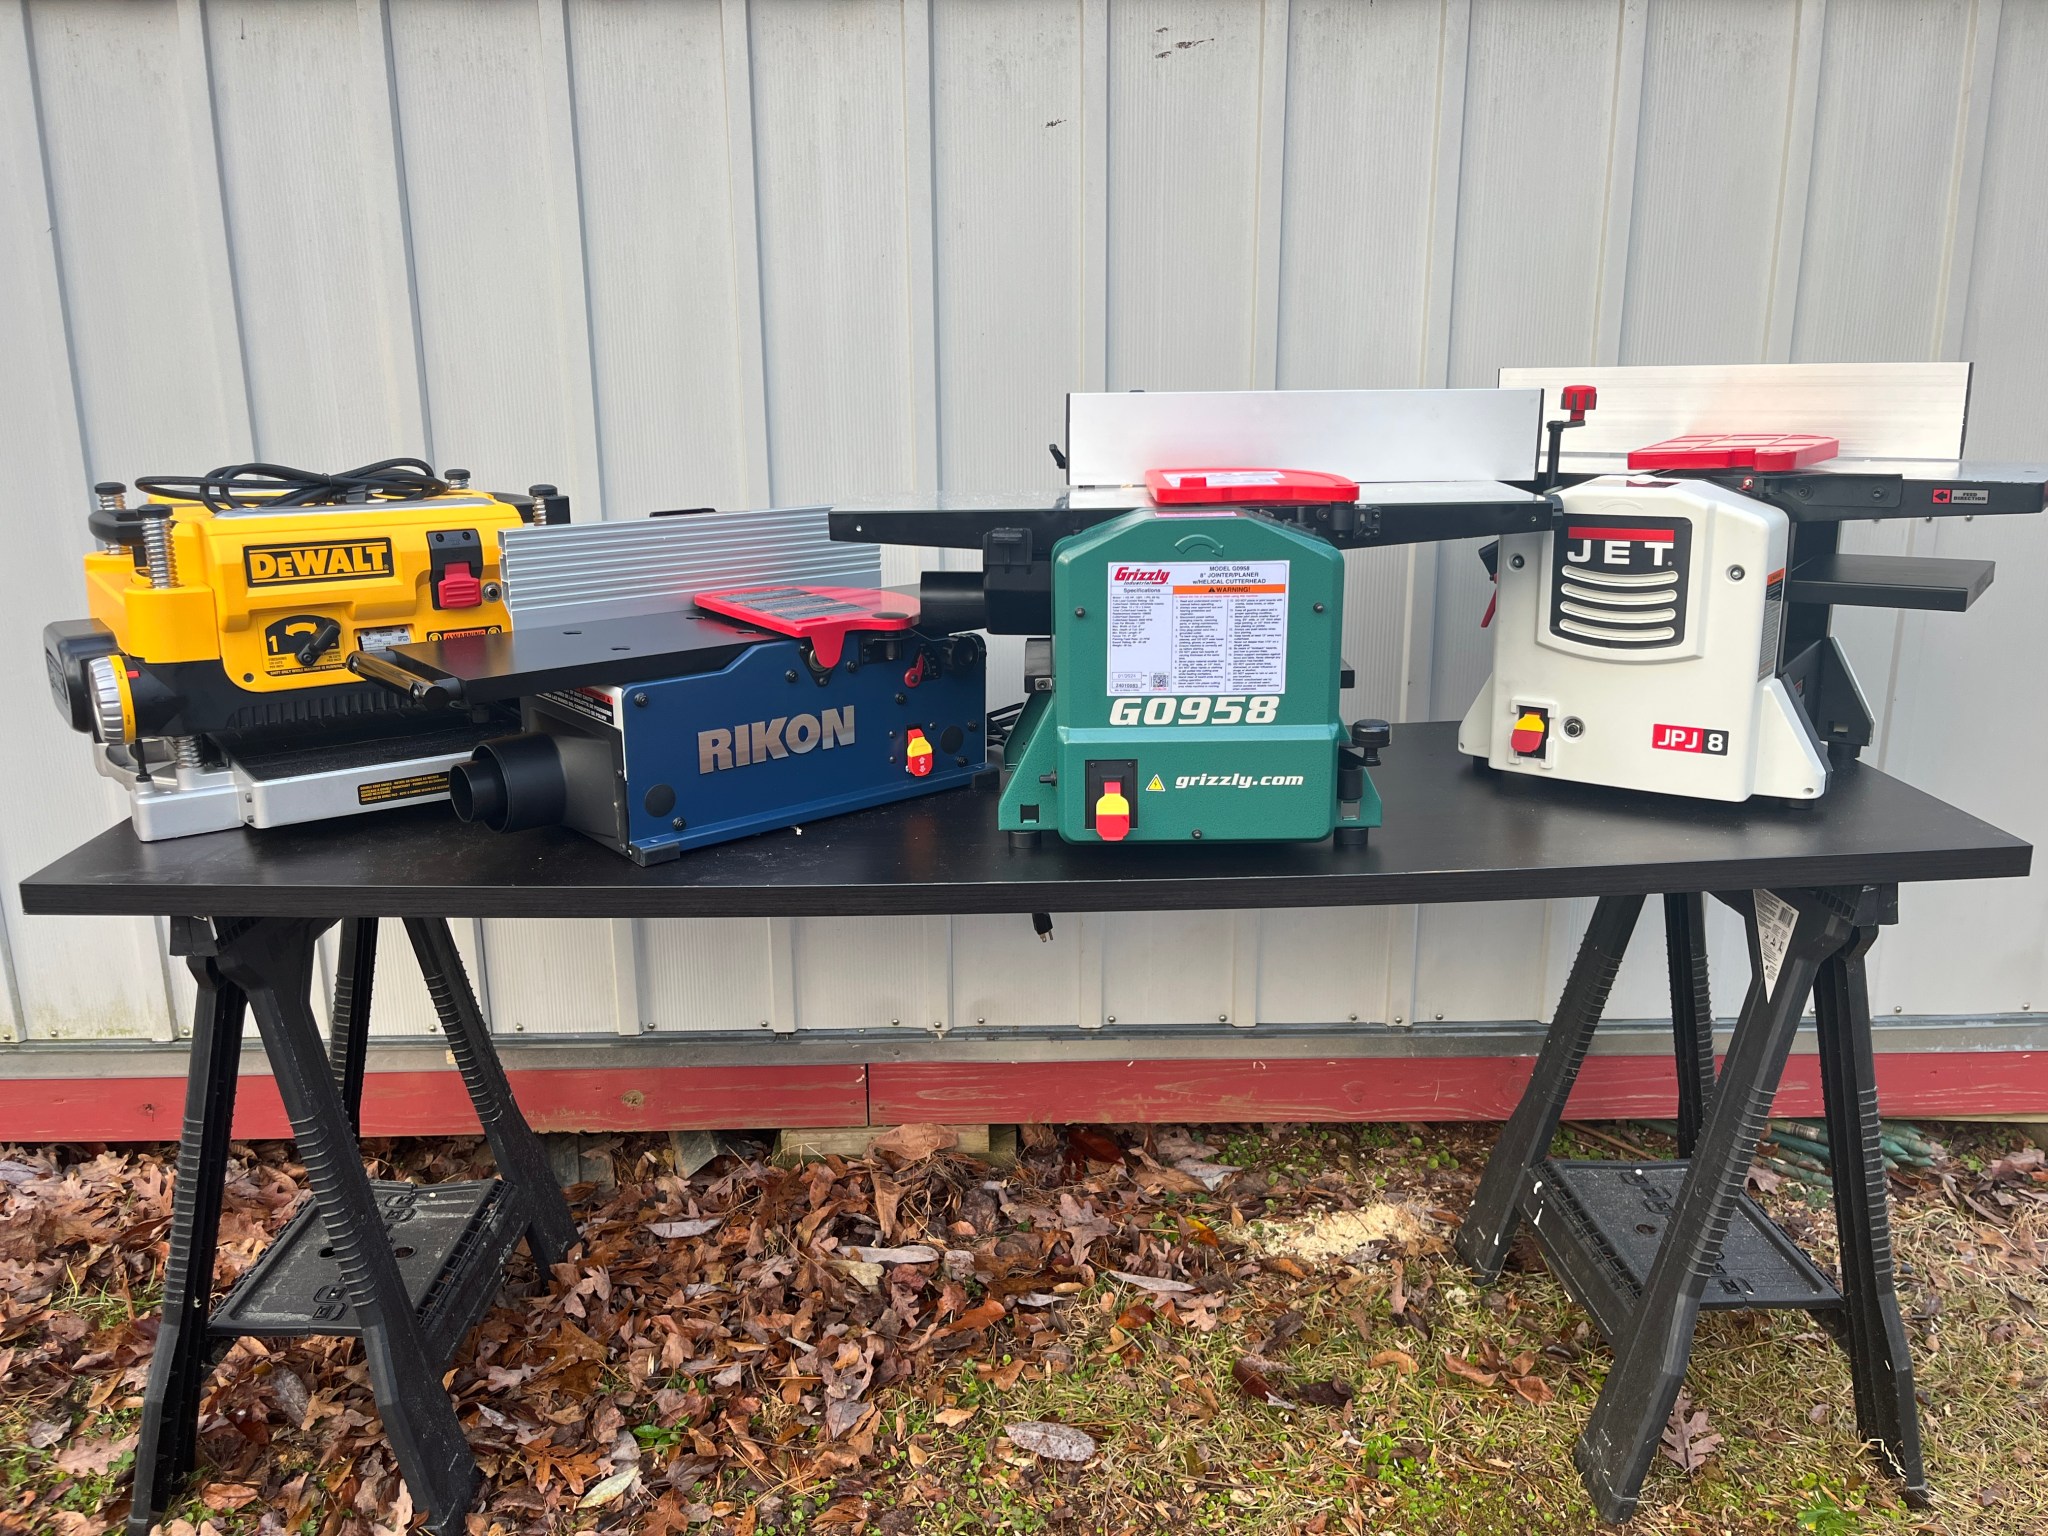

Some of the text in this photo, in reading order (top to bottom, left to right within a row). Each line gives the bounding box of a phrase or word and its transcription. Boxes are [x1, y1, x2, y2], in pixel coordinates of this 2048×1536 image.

[249, 545, 388, 580] DEWALT
[1566, 539, 1674, 567] JET
[1114, 566, 1170, 584] Grizzly
[268, 636, 278, 652] 1
[1109, 696, 1280, 726] G0958
[698, 704, 856, 775] RIKON
[1658, 728, 1724, 752] JPJ 8
[1175, 773, 1304, 788] grizzly.com
